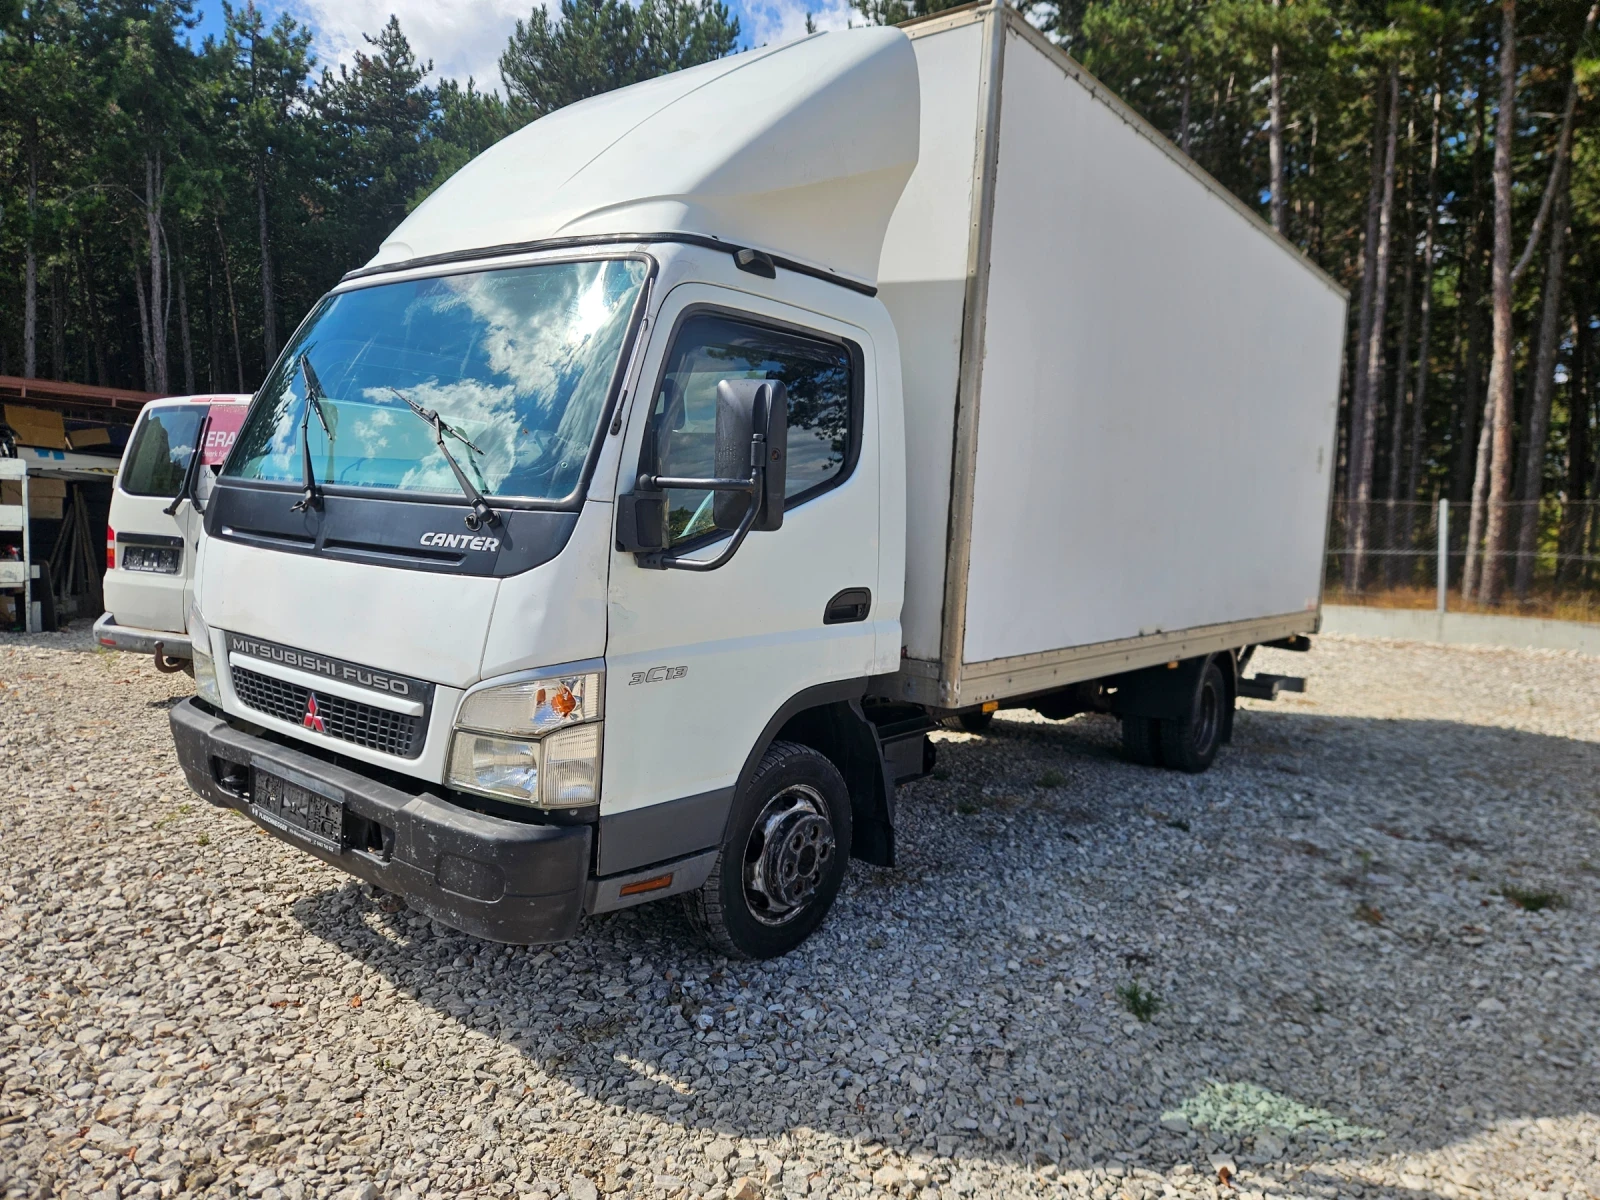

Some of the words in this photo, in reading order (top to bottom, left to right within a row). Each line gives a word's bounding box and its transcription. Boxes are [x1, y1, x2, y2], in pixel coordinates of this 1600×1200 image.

[420, 532, 500, 552] CANTER
[232, 638, 336, 676] MITSUBISHI
[343, 667, 409, 695] FUSO
[628, 665, 689, 686] 3C13
